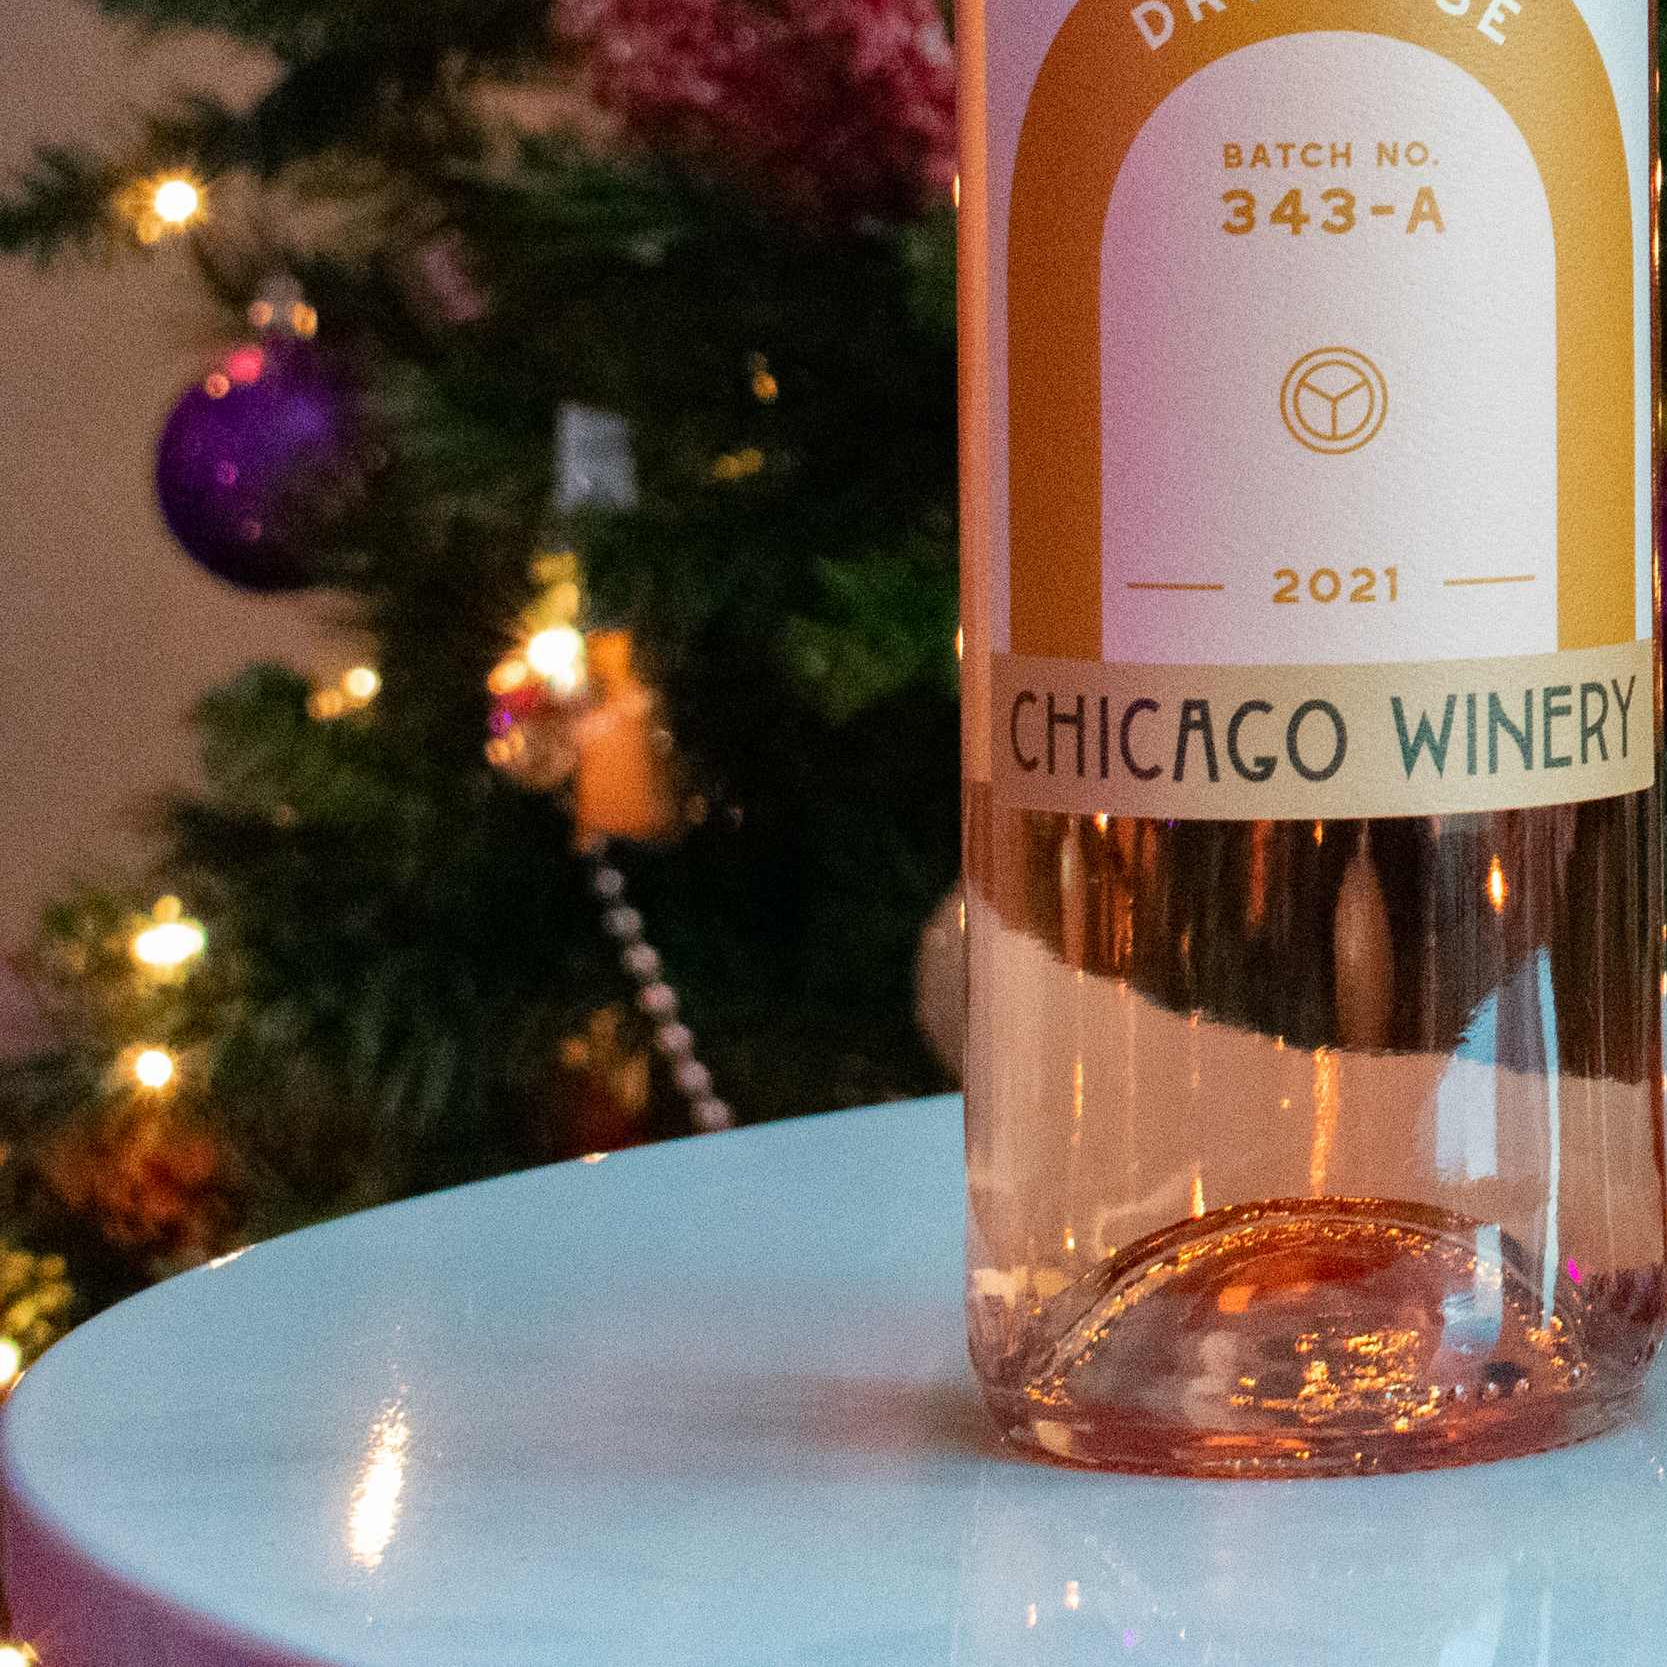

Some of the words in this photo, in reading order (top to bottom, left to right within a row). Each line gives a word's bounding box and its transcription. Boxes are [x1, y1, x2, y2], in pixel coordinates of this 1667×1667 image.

[1222, 142, 1353, 169] BATCH
[1376, 140, 1439, 167] NO.
[1221, 186, 1446, 236] 343-A
[1272, 567, 1401, 604] 2021
[1011, 690, 1348, 783] CHICAGO
[1389, 675, 1638, 781] WINERY
